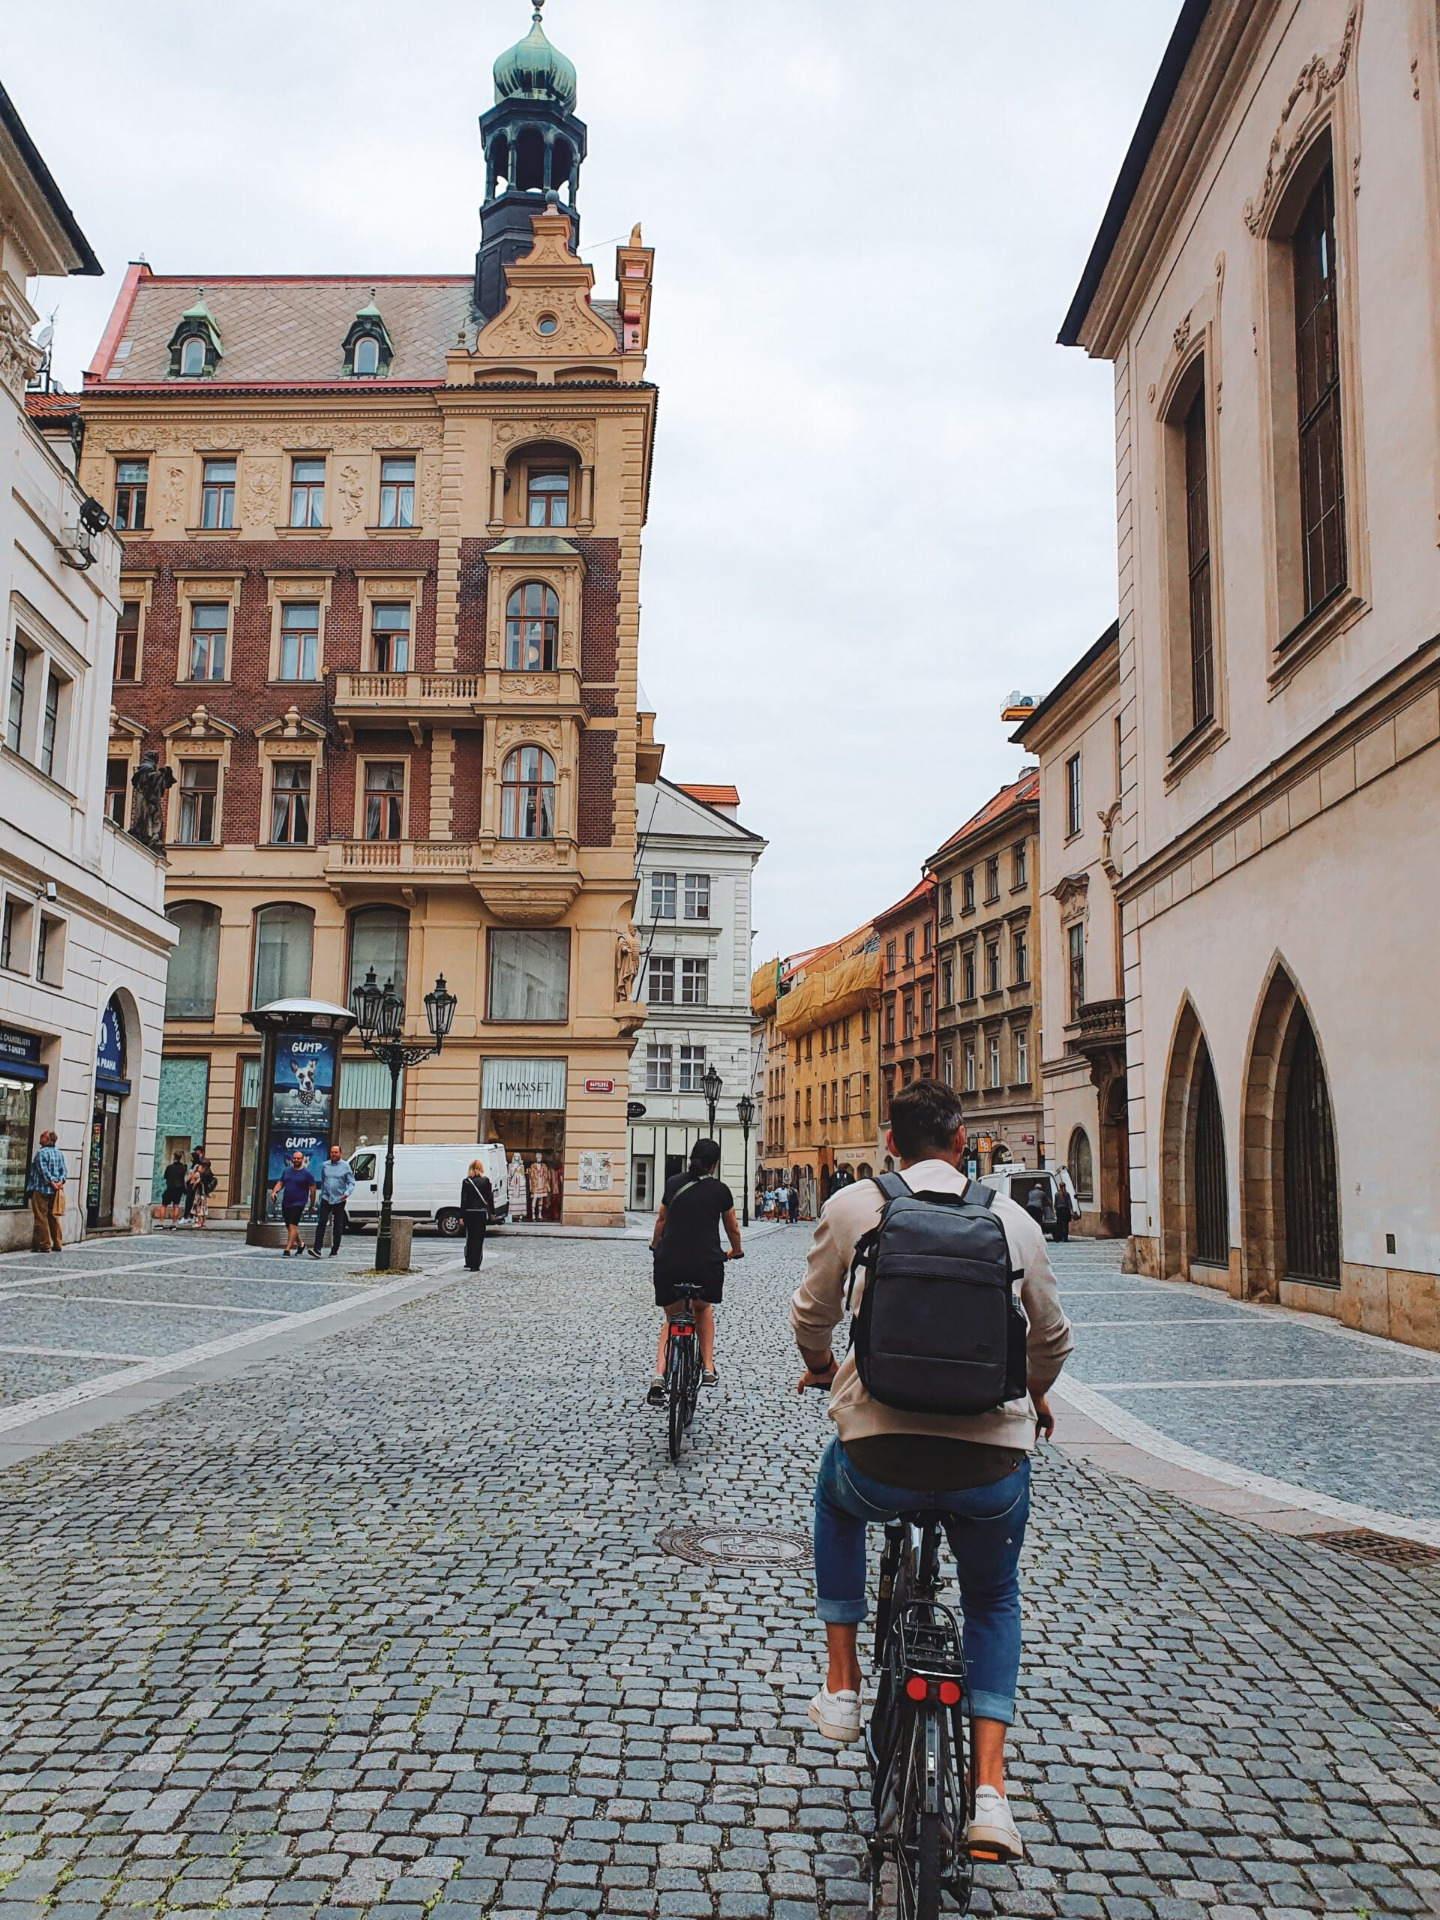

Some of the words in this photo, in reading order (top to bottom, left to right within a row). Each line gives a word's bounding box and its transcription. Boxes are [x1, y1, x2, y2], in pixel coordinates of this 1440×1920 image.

[291, 1042, 322, 1053] GUMP
[100, 1058, 116, 1071] PRAHA
[498, 1082, 551, 1092] TWINSET
[285, 1137, 317, 1148] GUMP
